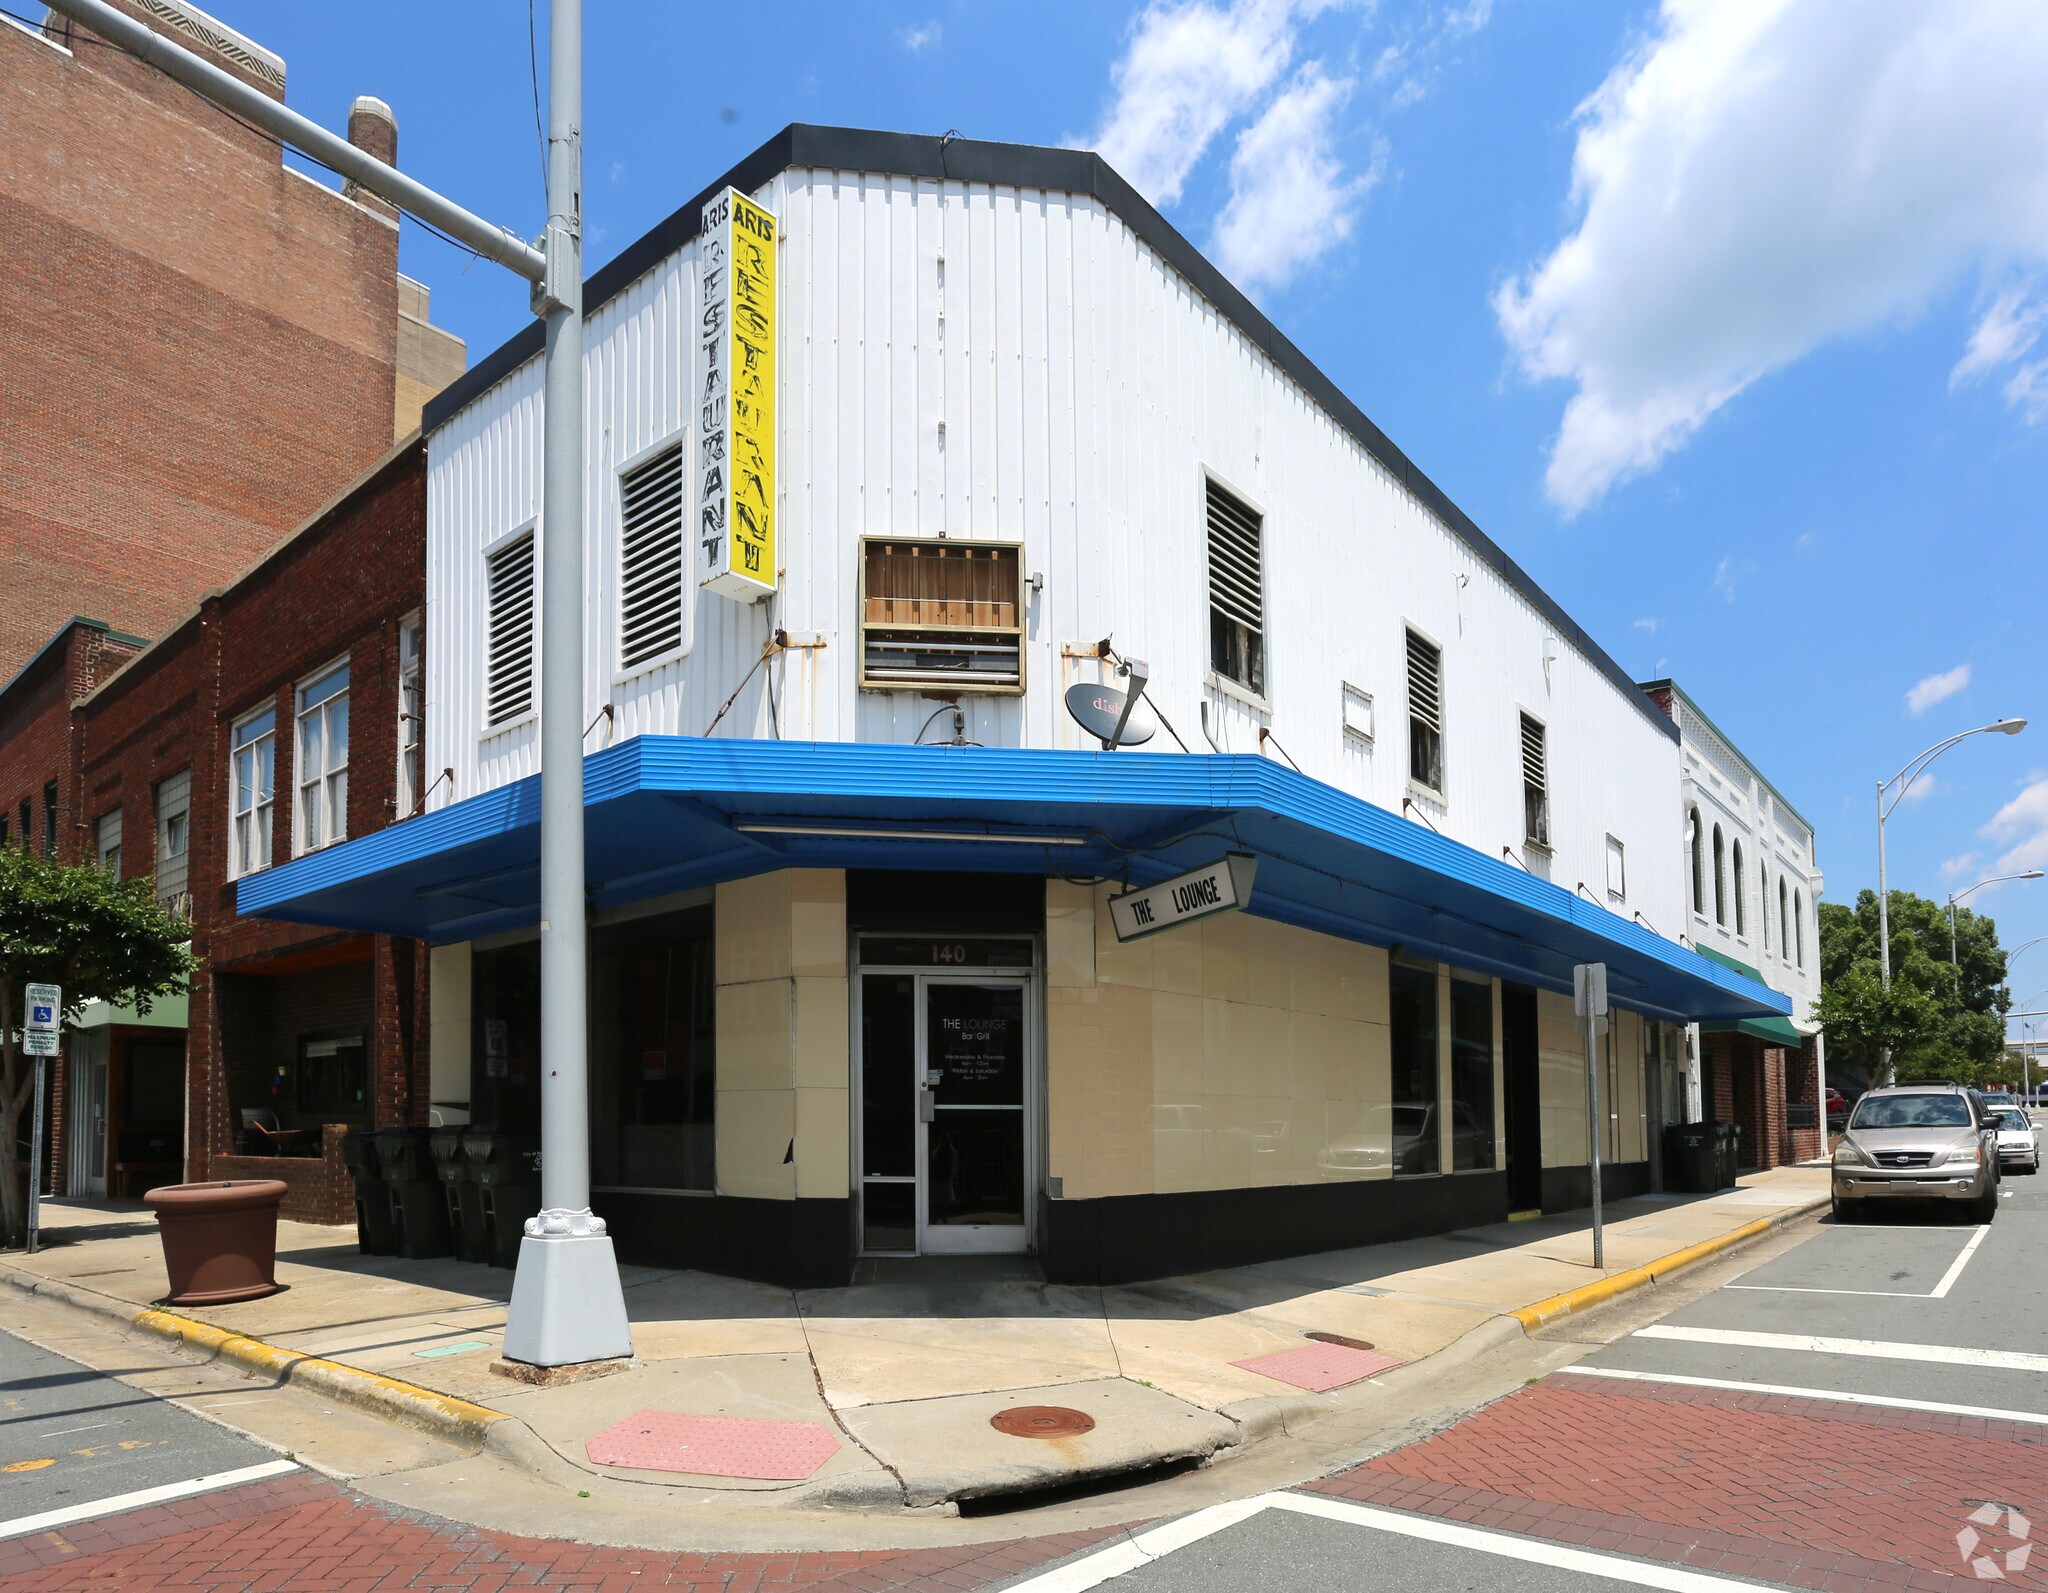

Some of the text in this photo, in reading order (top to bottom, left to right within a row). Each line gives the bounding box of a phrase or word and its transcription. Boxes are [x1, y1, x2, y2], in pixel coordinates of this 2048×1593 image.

[702, 197, 729, 238] ARIS
[733, 202, 774, 242] ARIS
[702, 236, 726, 568] RESTAURANT
[1131, 876, 1221, 926] THE LOUNGE
[932, 944, 966, 963] 140
[943, 1018, 1008, 1030] THE LOUNGE
[961, 1032, 990, 1040] Bar Grill
